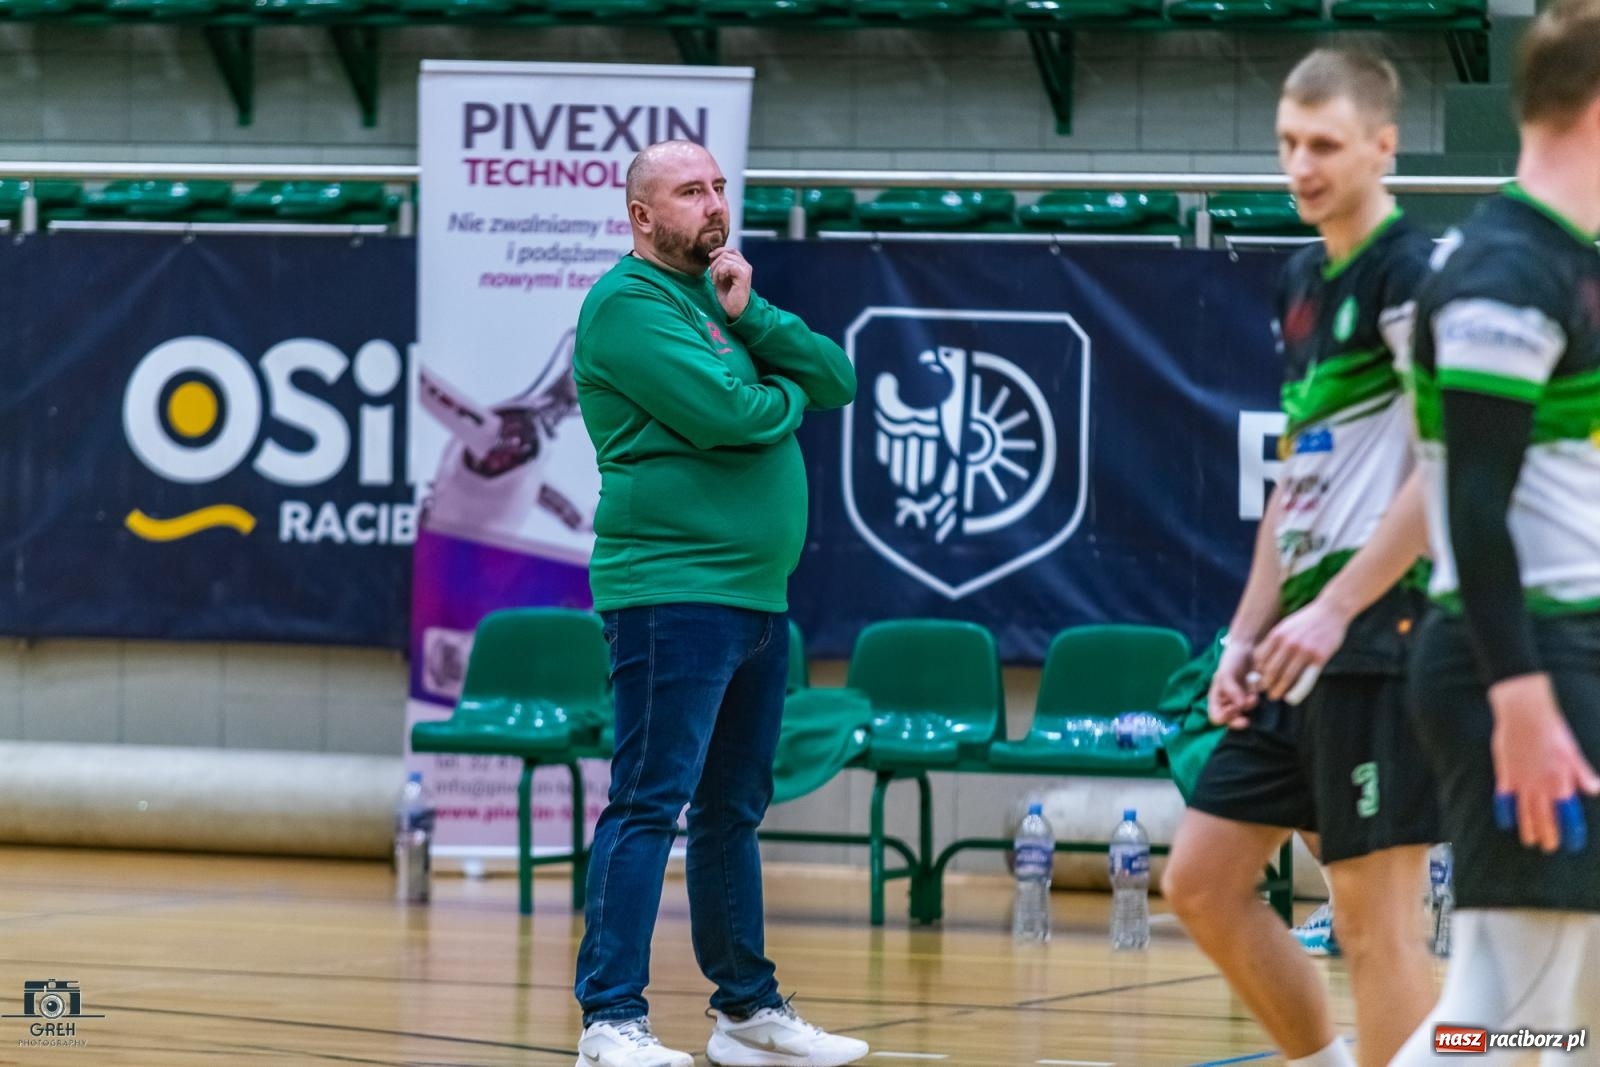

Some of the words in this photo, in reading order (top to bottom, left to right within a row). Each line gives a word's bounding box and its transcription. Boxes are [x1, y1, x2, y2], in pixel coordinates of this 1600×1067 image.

[462, 101, 707, 152] PIVEXIN
[448, 212, 484, 232] Nie
[489, 214, 600, 237] zwalniamy
[479, 269, 563, 293] nowymi
[1351, 760, 1380, 818] 3
